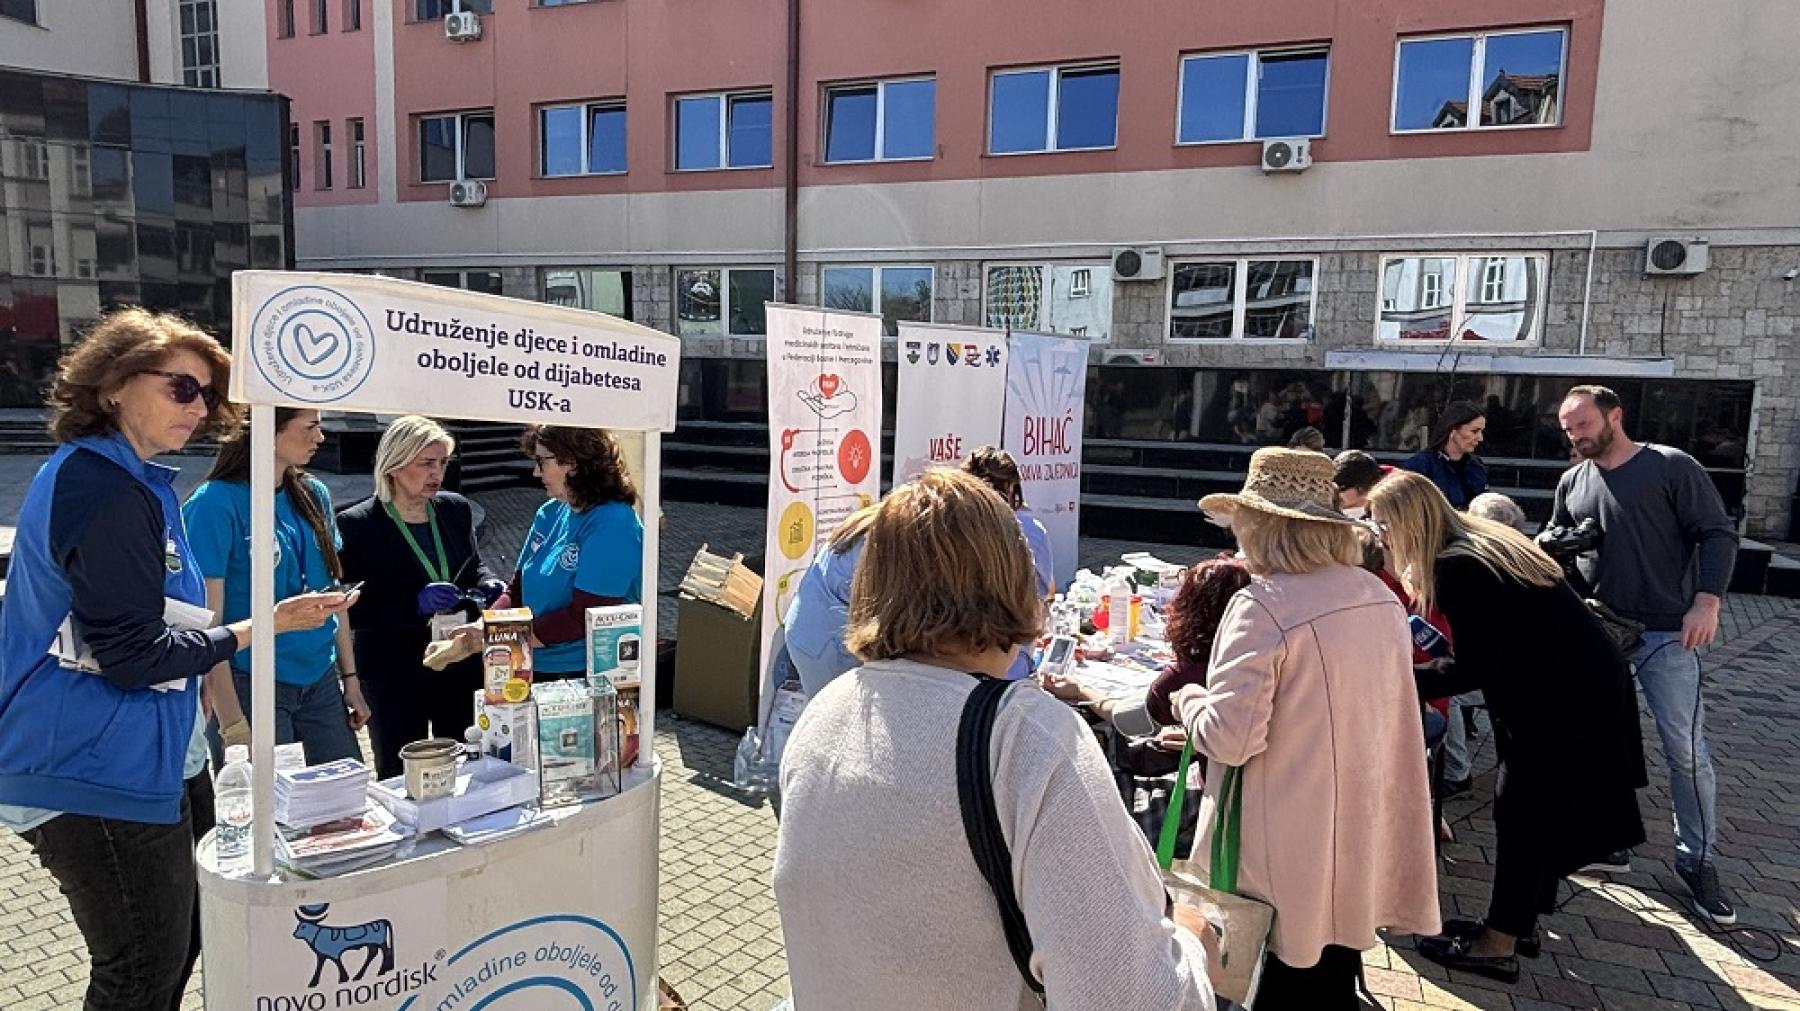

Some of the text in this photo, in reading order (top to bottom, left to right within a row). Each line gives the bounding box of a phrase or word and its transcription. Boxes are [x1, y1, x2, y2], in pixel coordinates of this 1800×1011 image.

[385, 309, 667, 367] Udruženje djece i omladine
[417, 348, 641, 391] oboljele od dijabetesa
[508, 389, 571, 412] USK-a
[930, 433, 961, 460] VAŠE
[1023, 408, 1073, 455] BIHAĆ
[489, 632, 517, 643] LUNA
[257, 961, 437, 1011] novo nordisk
[436, 941, 619, 1011] mladine oboljele od
